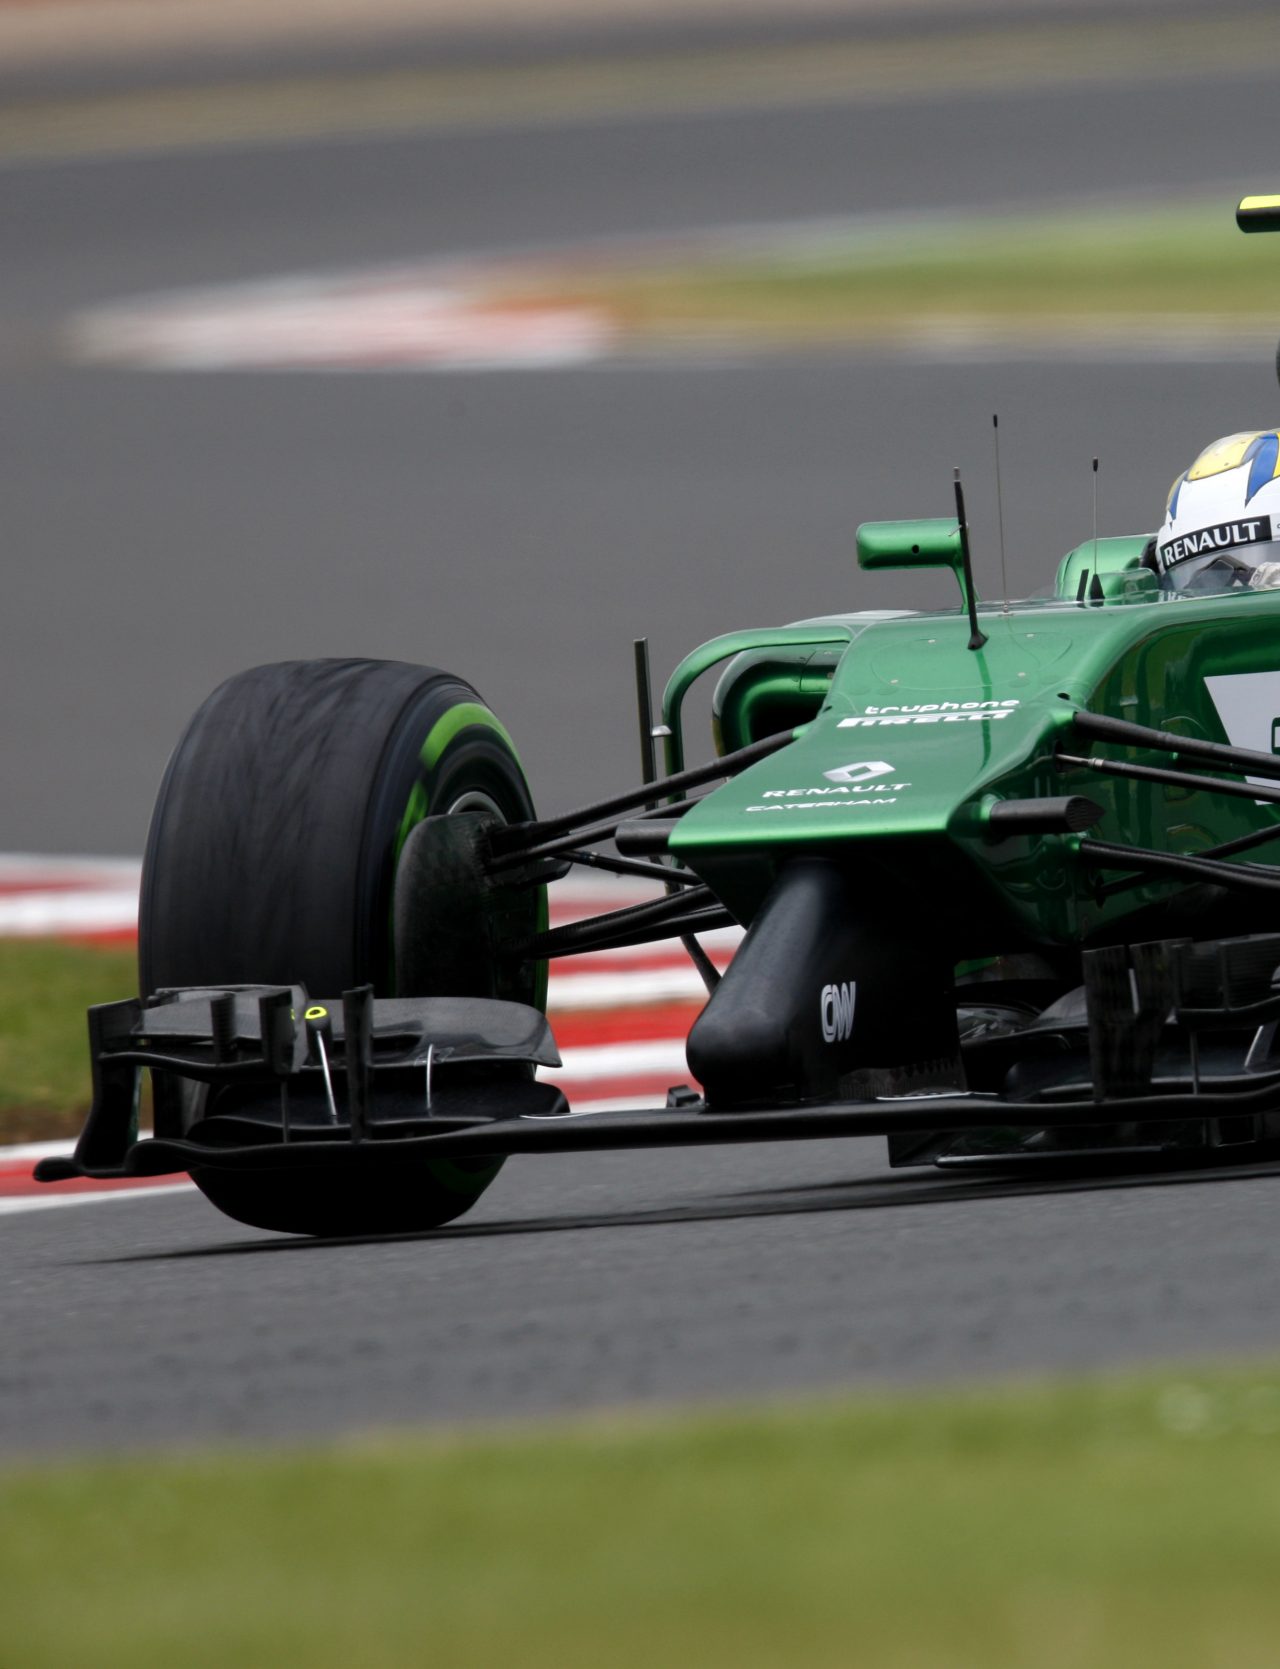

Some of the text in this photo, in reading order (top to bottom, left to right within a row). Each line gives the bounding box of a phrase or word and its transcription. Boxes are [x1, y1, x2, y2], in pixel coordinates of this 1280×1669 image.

[1164, 520, 1261, 566] RENAULT
[864, 699, 1020, 715] truphone
[762, 783, 912, 798] RENAULT
[745, 798, 897, 812] CATERHAM
